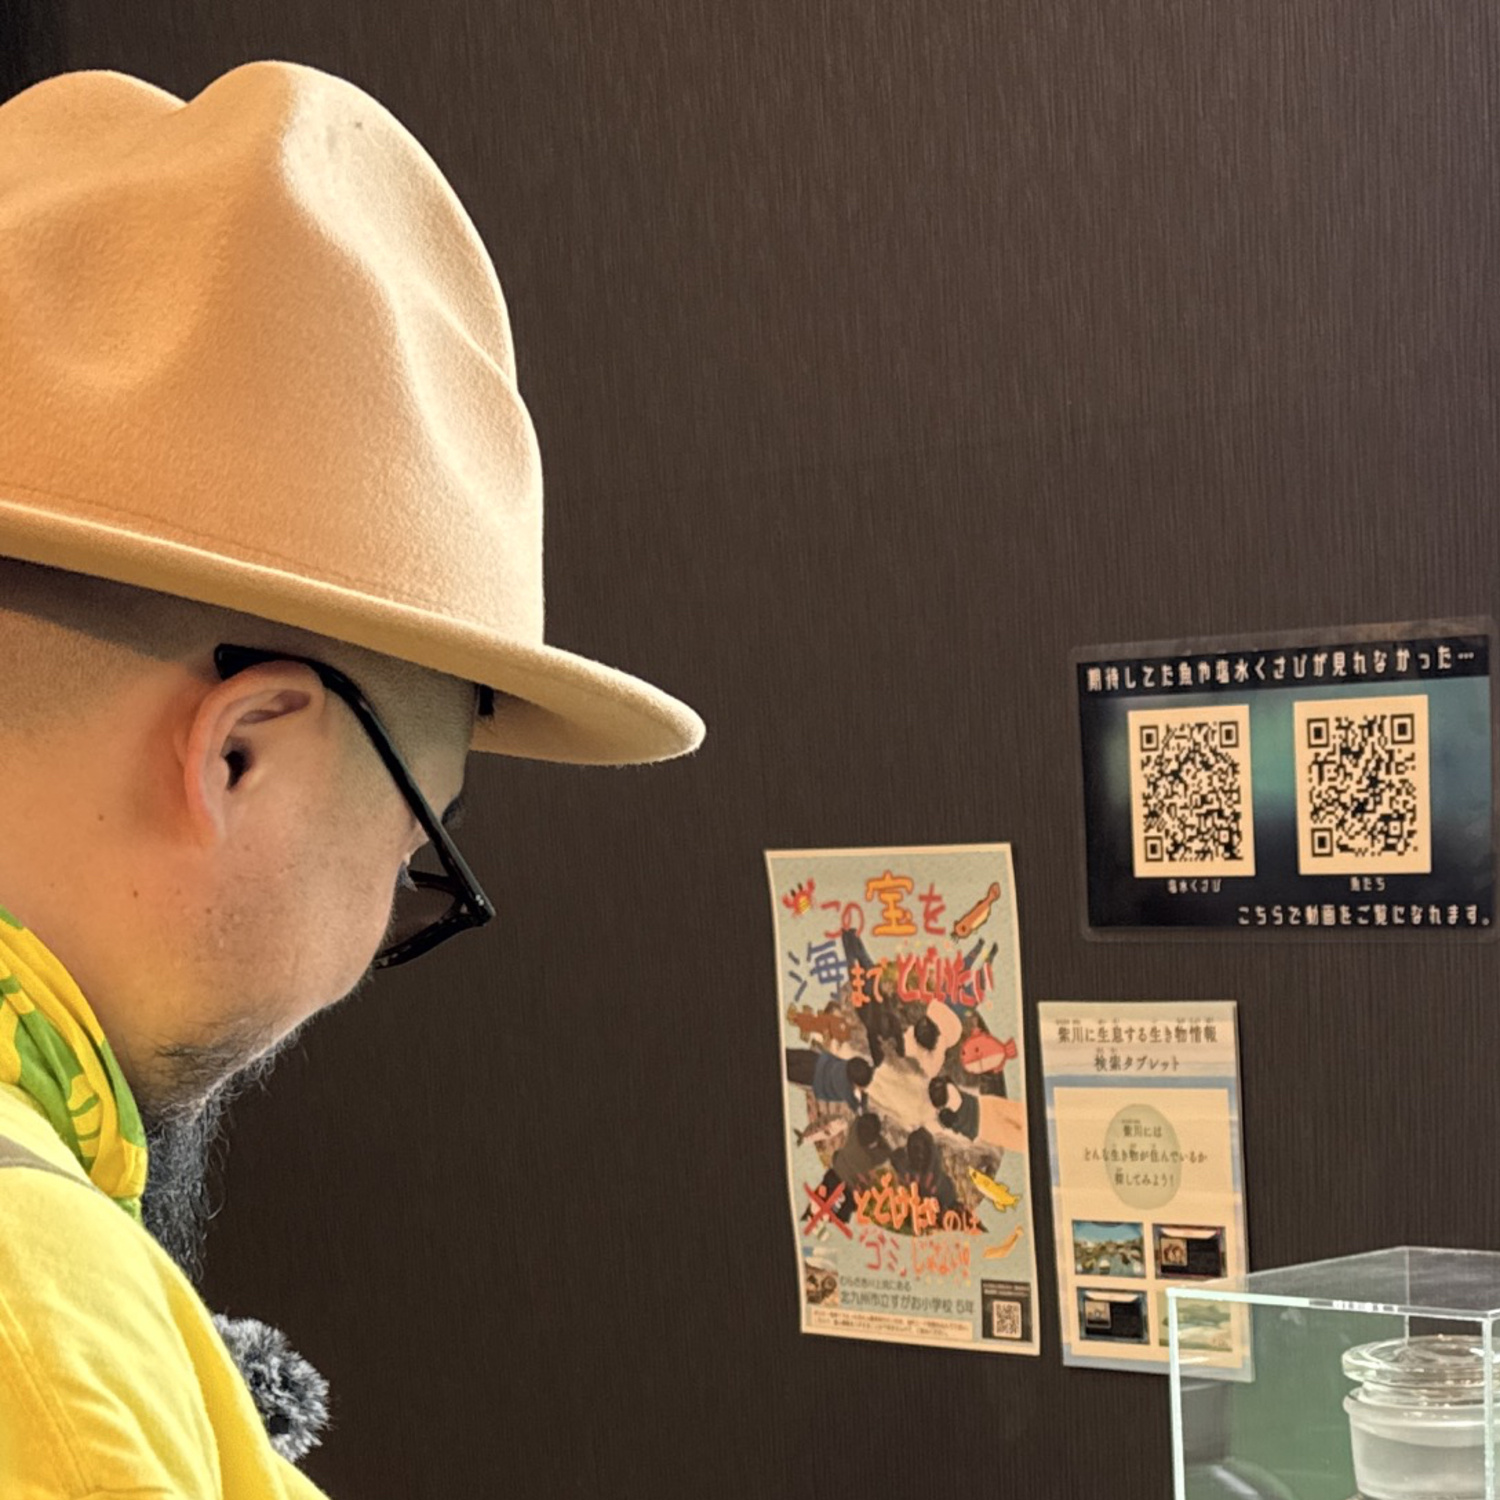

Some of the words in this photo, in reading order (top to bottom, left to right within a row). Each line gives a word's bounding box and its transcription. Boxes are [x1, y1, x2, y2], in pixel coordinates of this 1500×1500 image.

[1351, 877, 1385, 892] 魚たち
[821, 870, 946, 939] この宝を
[1238, 905, 1490, 926] こちらで動画をご覧になれます。
[1094, 1056, 1180, 1071] 検索タブレット
